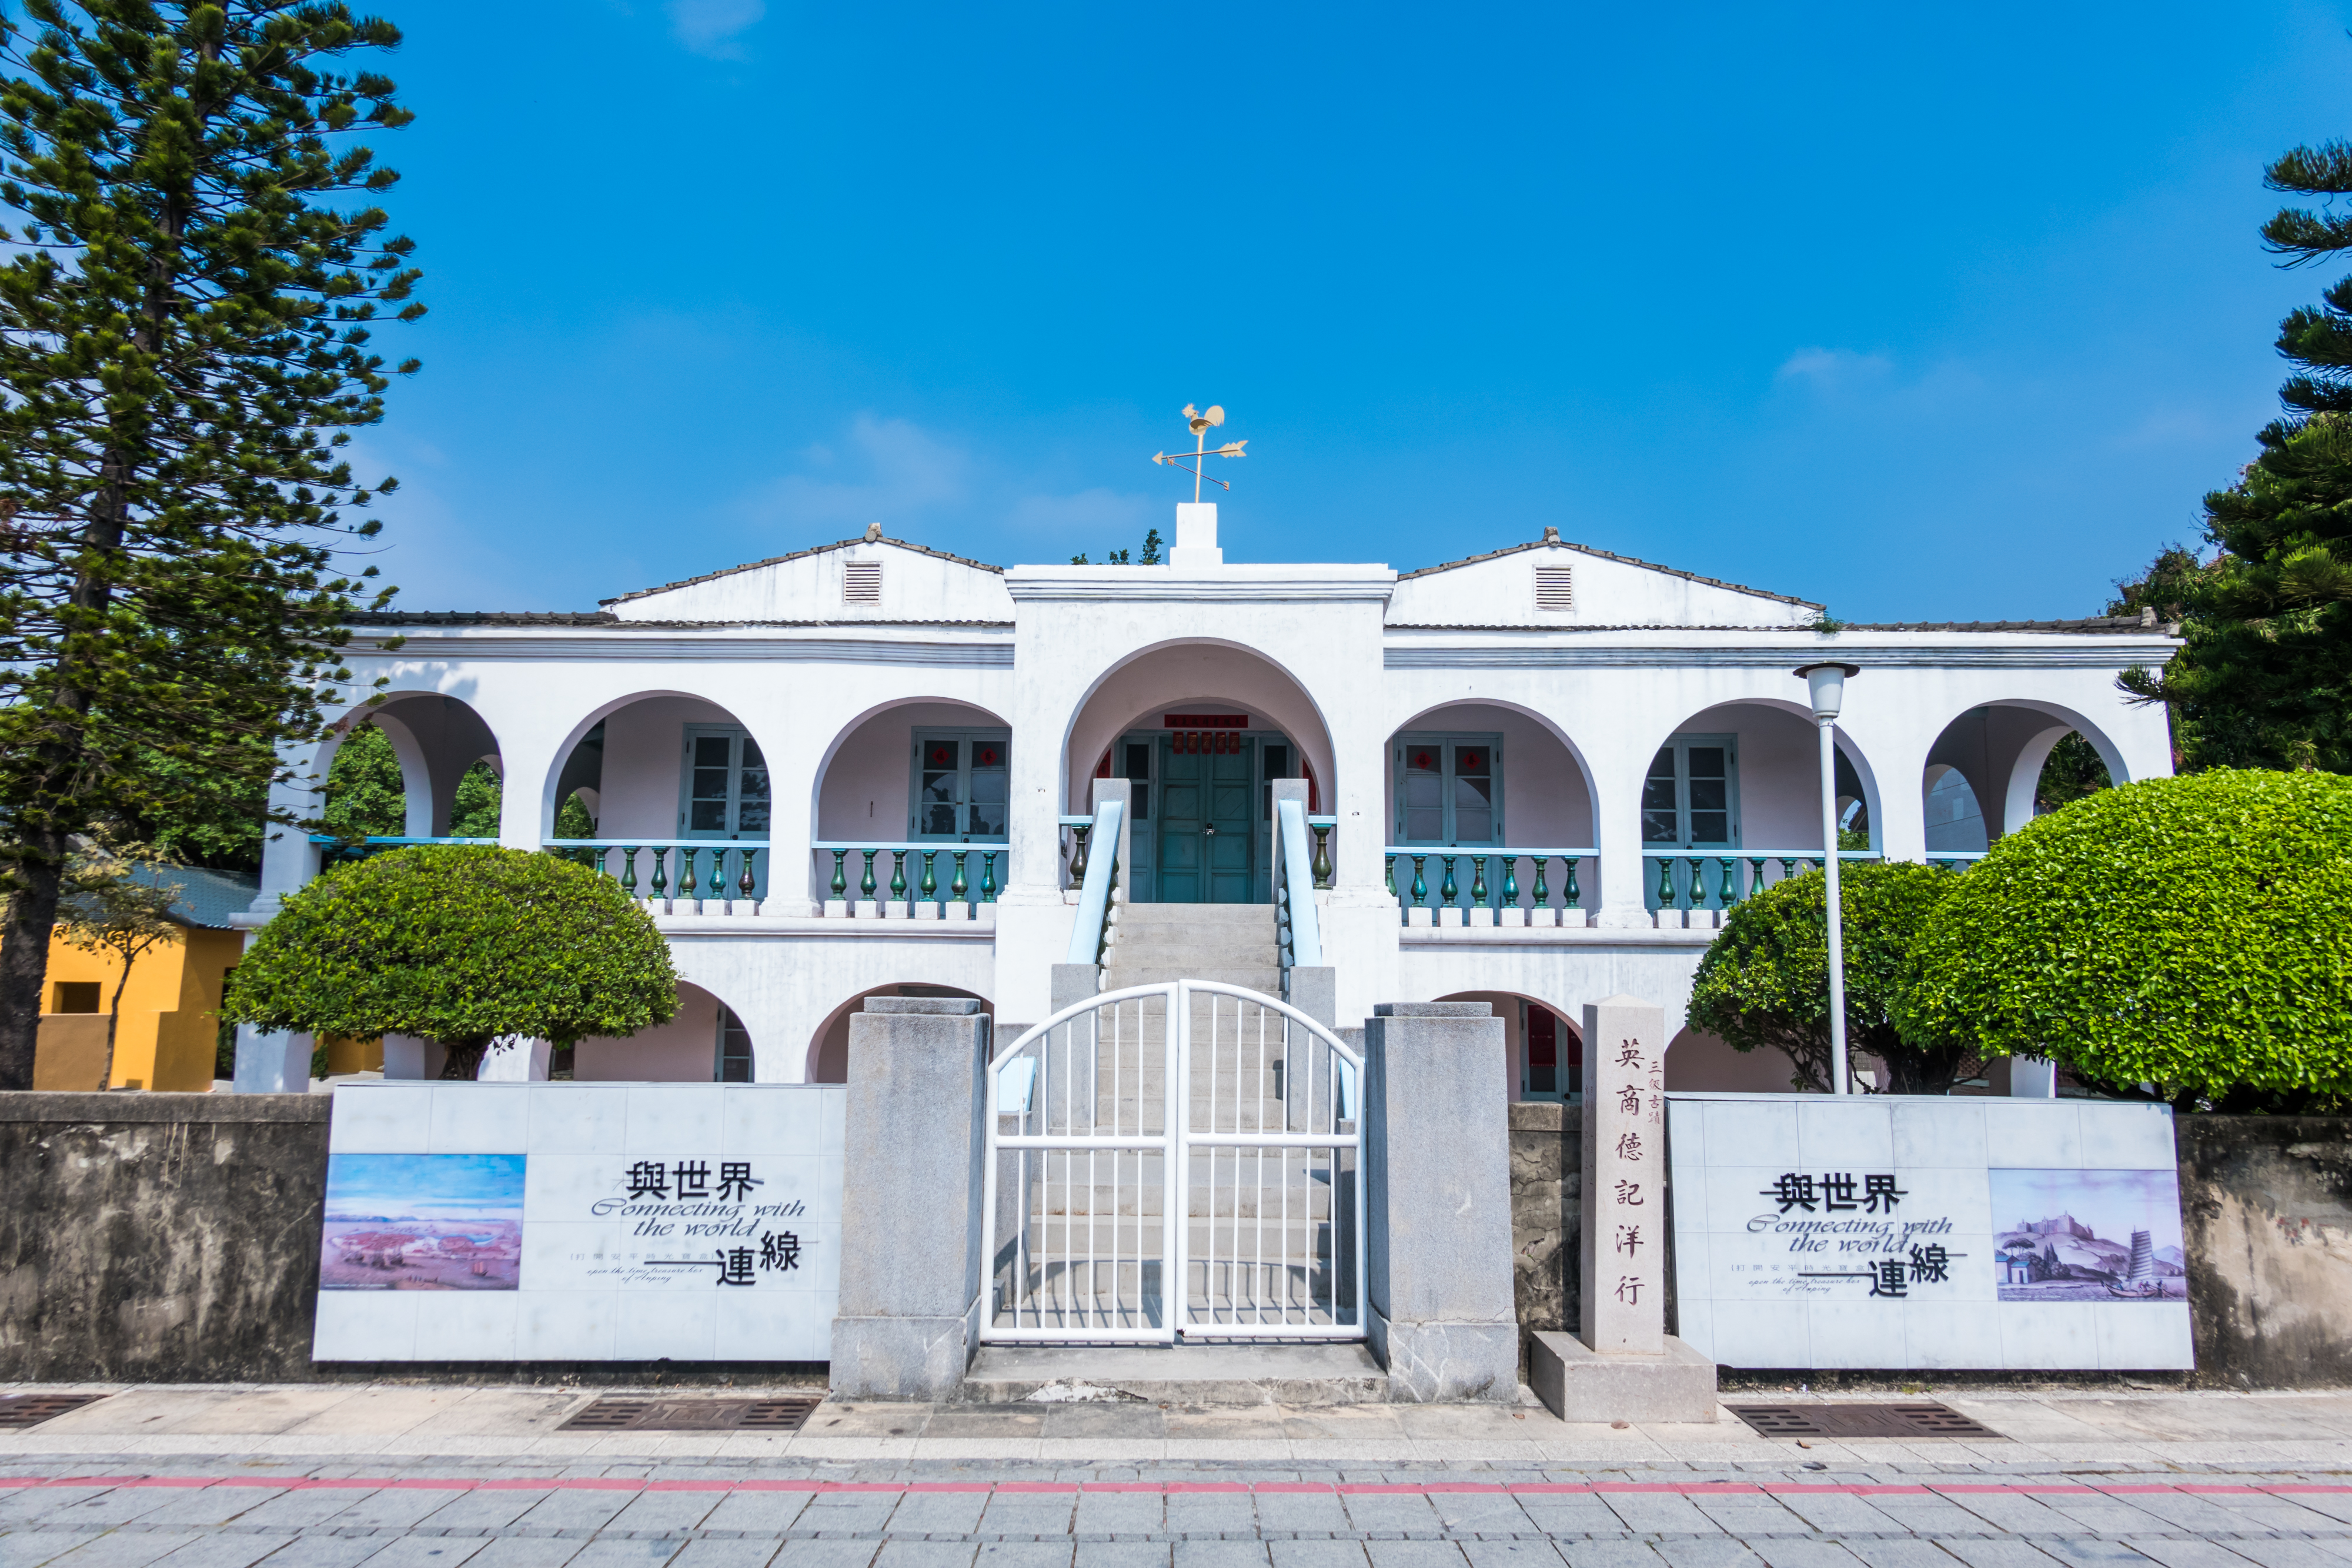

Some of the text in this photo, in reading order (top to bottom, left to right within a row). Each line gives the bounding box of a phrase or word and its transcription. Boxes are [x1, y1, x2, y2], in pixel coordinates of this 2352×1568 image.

[1648, 1061, 1663, 1125] 三級古蹟
[625, 1161, 754, 1202] 與世界
[1614, 1038, 1645, 1306] 英商德記洋行
[1773, 1172, 1900, 1213] 與世界
[591, 1198, 806, 1222] Connecting with
[634, 1218, 761, 1237] the world
[1746, 1213, 1953, 1238] Connecting with
[1789, 1234, 1910, 1253] the world
[610, 1266, 625, 1274] the
[686, 1265, 703, 1273] box
[621, 1271, 672, 1284] of Anping
[1748, 1279, 1769, 1288] open
[1845, 1276, 1860, 1284] box
[1783, 1282, 1832, 1295] of Anping
